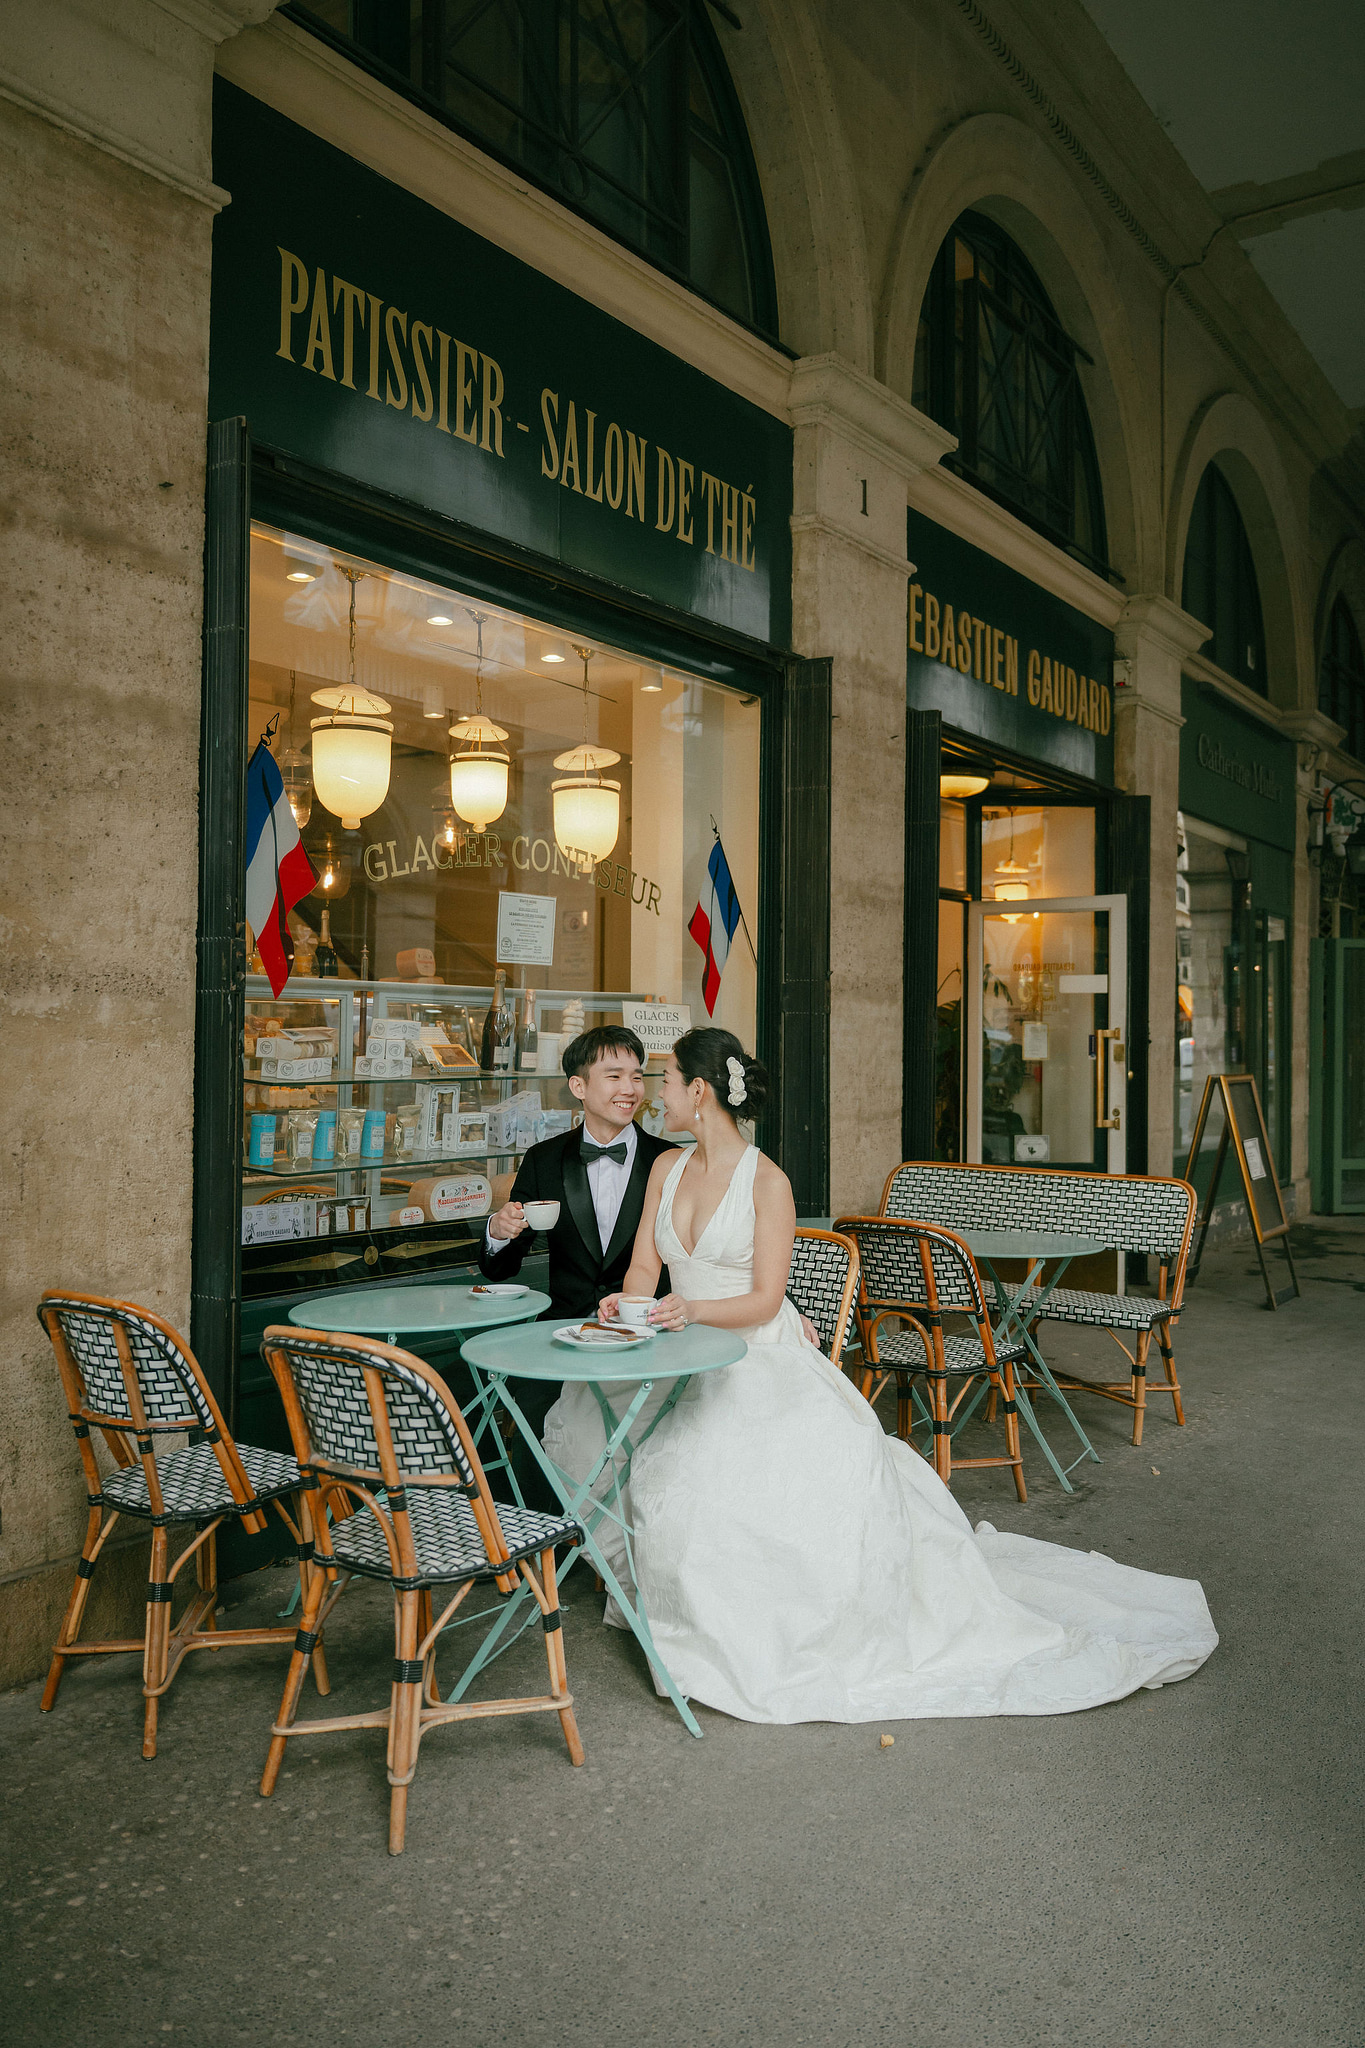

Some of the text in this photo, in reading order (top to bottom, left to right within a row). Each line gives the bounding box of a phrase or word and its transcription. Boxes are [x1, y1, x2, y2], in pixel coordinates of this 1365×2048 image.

[275, 245, 506, 459] PATISSIER
[541, 388, 648, 523] SALON
[654, 445, 695, 545] DE
[701, 470, 756, 573] THÉ
[860, 479, 869, 517] 1
[908, 583, 1111, 737] ÉBASTIEN GAUDARD
[363, 832, 662, 916] GLACIER CONFISEUR
[632, 1024, 684, 1036] SORBETS
[634, 1010, 679, 1022] GLACES
